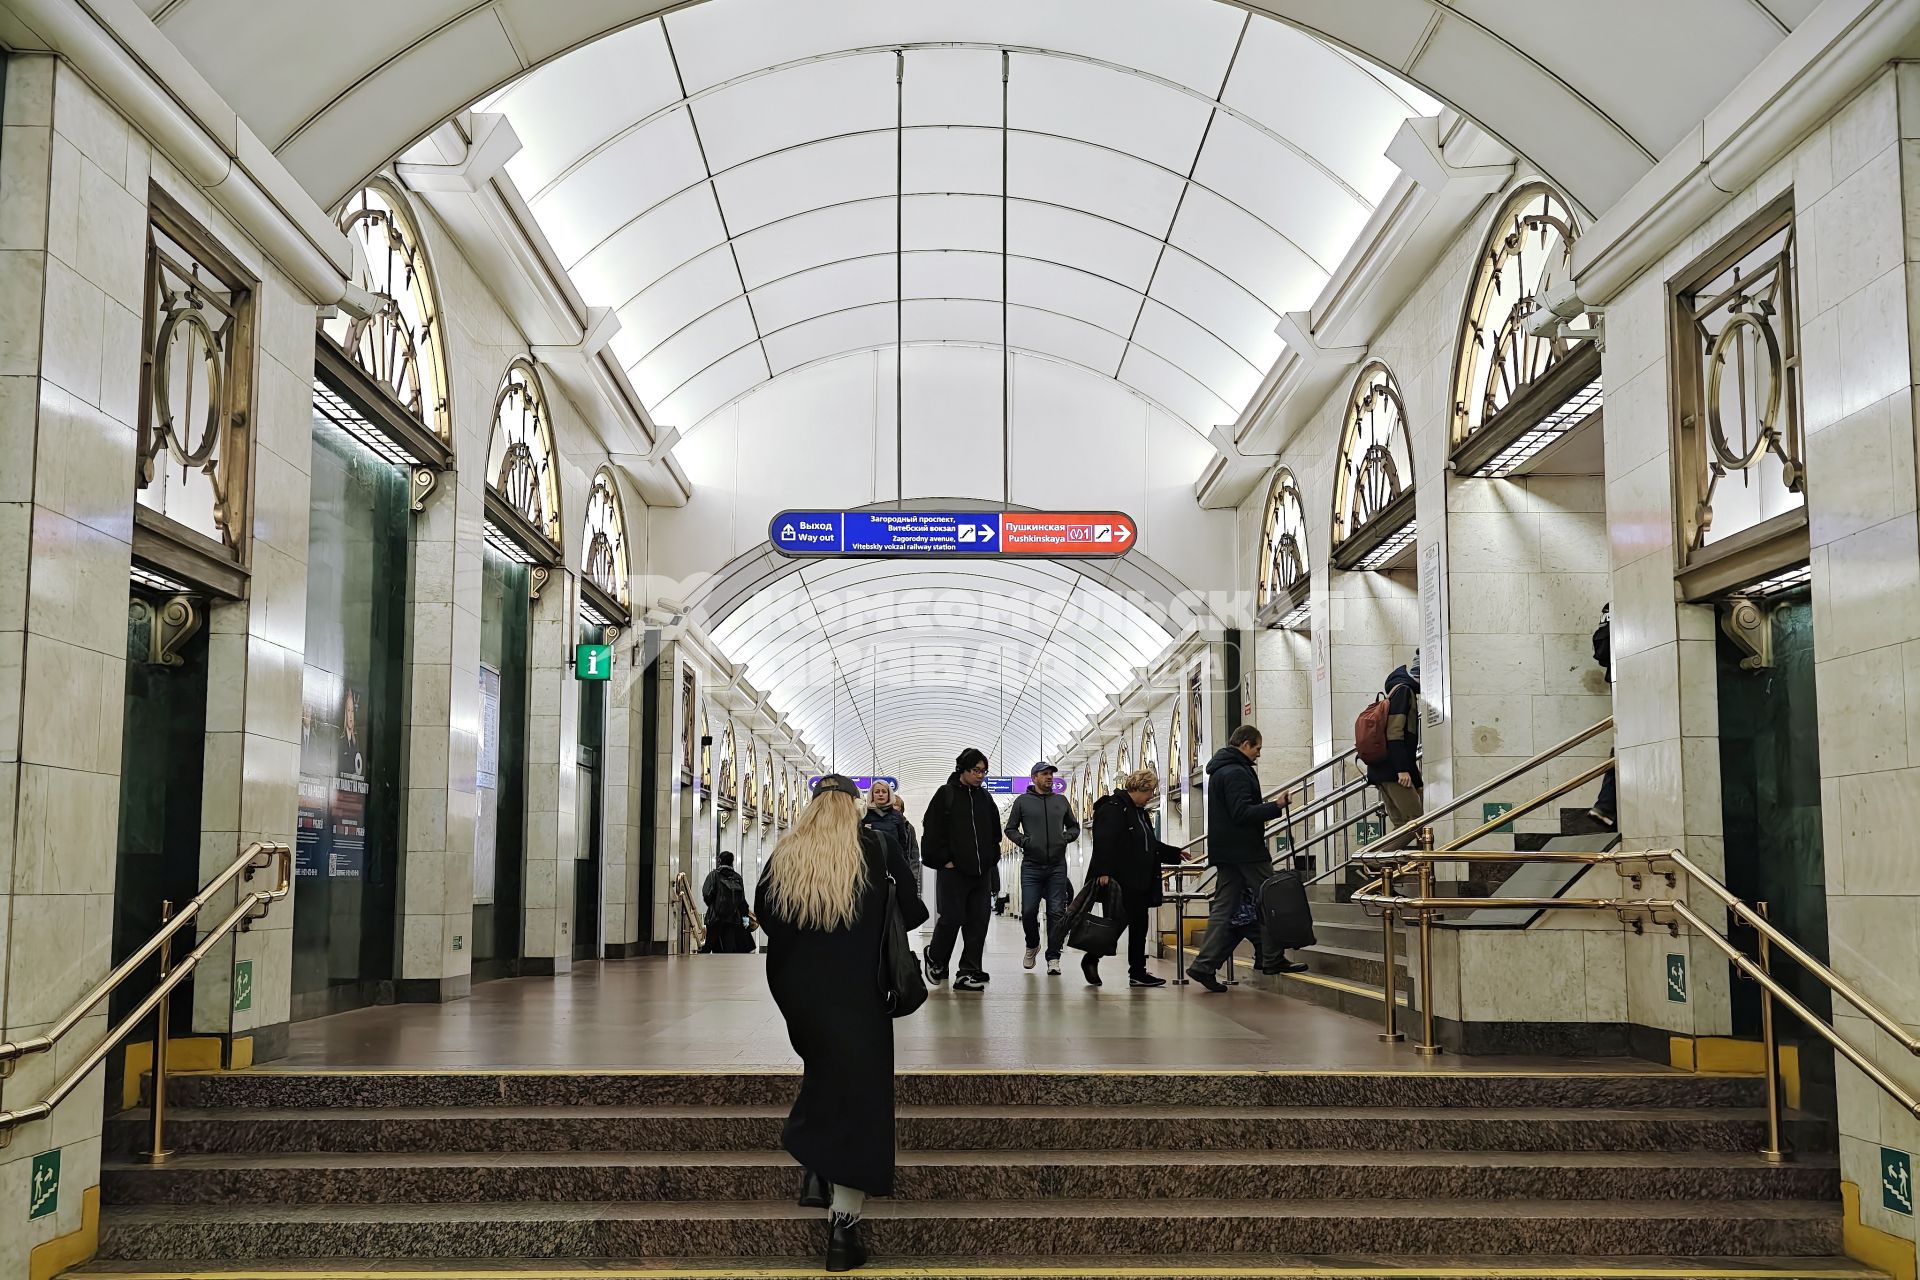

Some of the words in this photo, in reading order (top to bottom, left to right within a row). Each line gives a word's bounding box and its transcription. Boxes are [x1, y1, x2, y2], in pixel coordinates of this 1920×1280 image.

[870, 515, 918, 524] Загородный
[919, 516, 956, 525] проспект,
[799, 521, 833, 532] Выход
[887, 524, 928, 532] Витебский
[1005, 522, 1066, 532] Пушкинская
[798, 533, 818, 543] Way
[819, 534, 835, 542] out
[892, 535, 929, 543] Zagorodny
[1008, 534, 1066, 544] Pushkinskaya
[906, 543, 932, 552] railway
